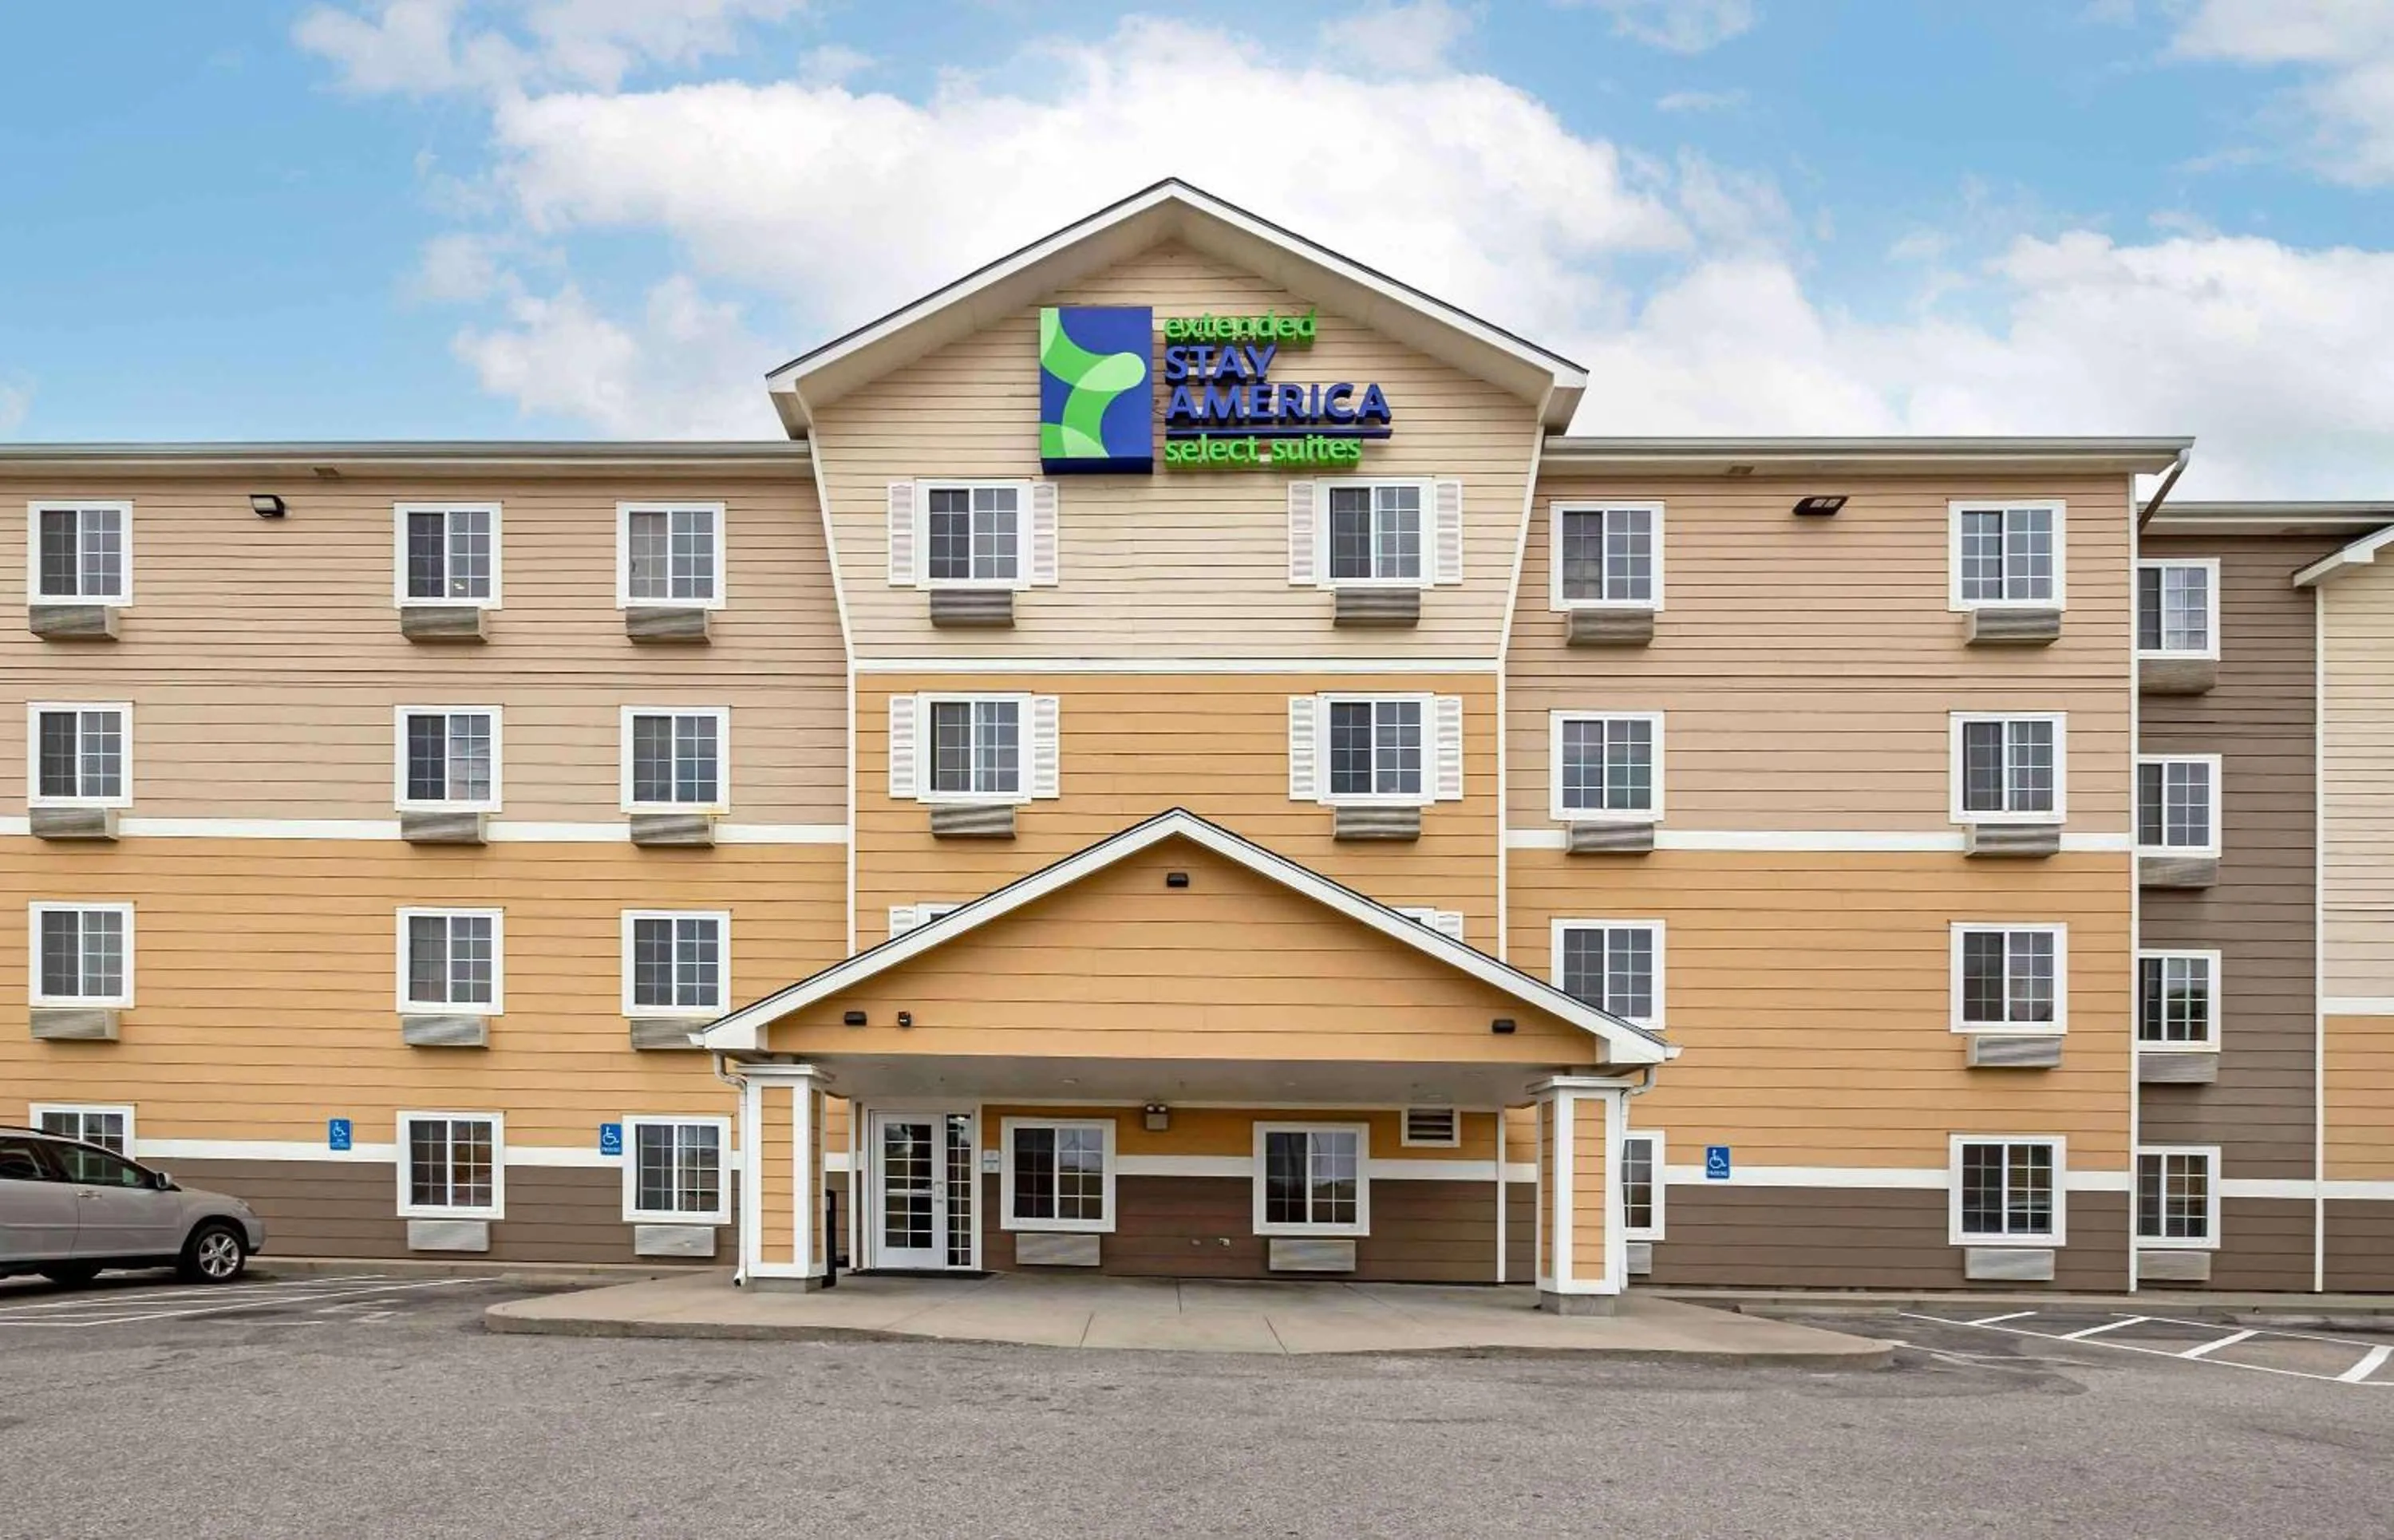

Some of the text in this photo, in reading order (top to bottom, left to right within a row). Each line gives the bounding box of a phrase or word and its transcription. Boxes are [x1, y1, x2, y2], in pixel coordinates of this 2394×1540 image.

[1164, 308, 1316, 341] extended
[1165, 345, 1276, 382] STAY
[1166, 383, 1392, 423] AMERICA
[1164, 434, 1362, 464] select suites
